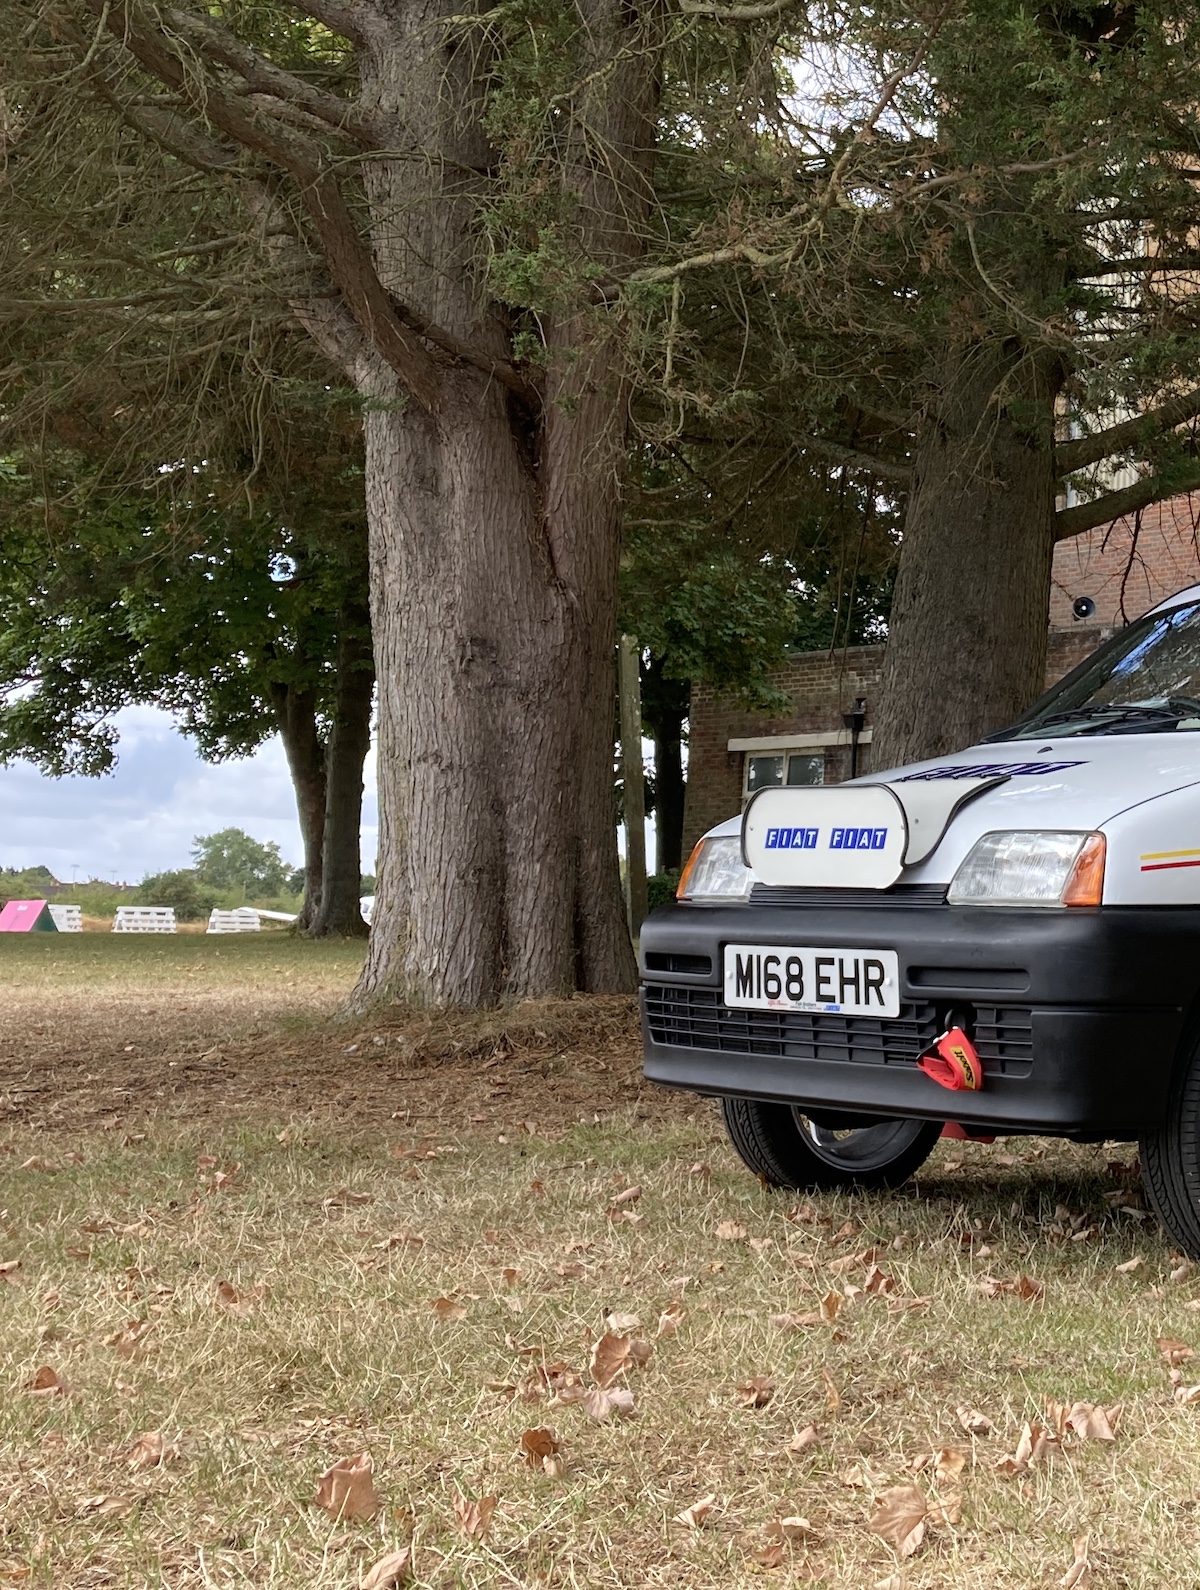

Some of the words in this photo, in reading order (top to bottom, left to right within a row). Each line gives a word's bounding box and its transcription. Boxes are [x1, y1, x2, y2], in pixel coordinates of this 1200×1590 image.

[767, 829, 817, 847] FIAT
[831, 829, 886, 848] FIAT
[735, 953, 804, 1001] M168
[814, 956, 886, 1007] EHR
